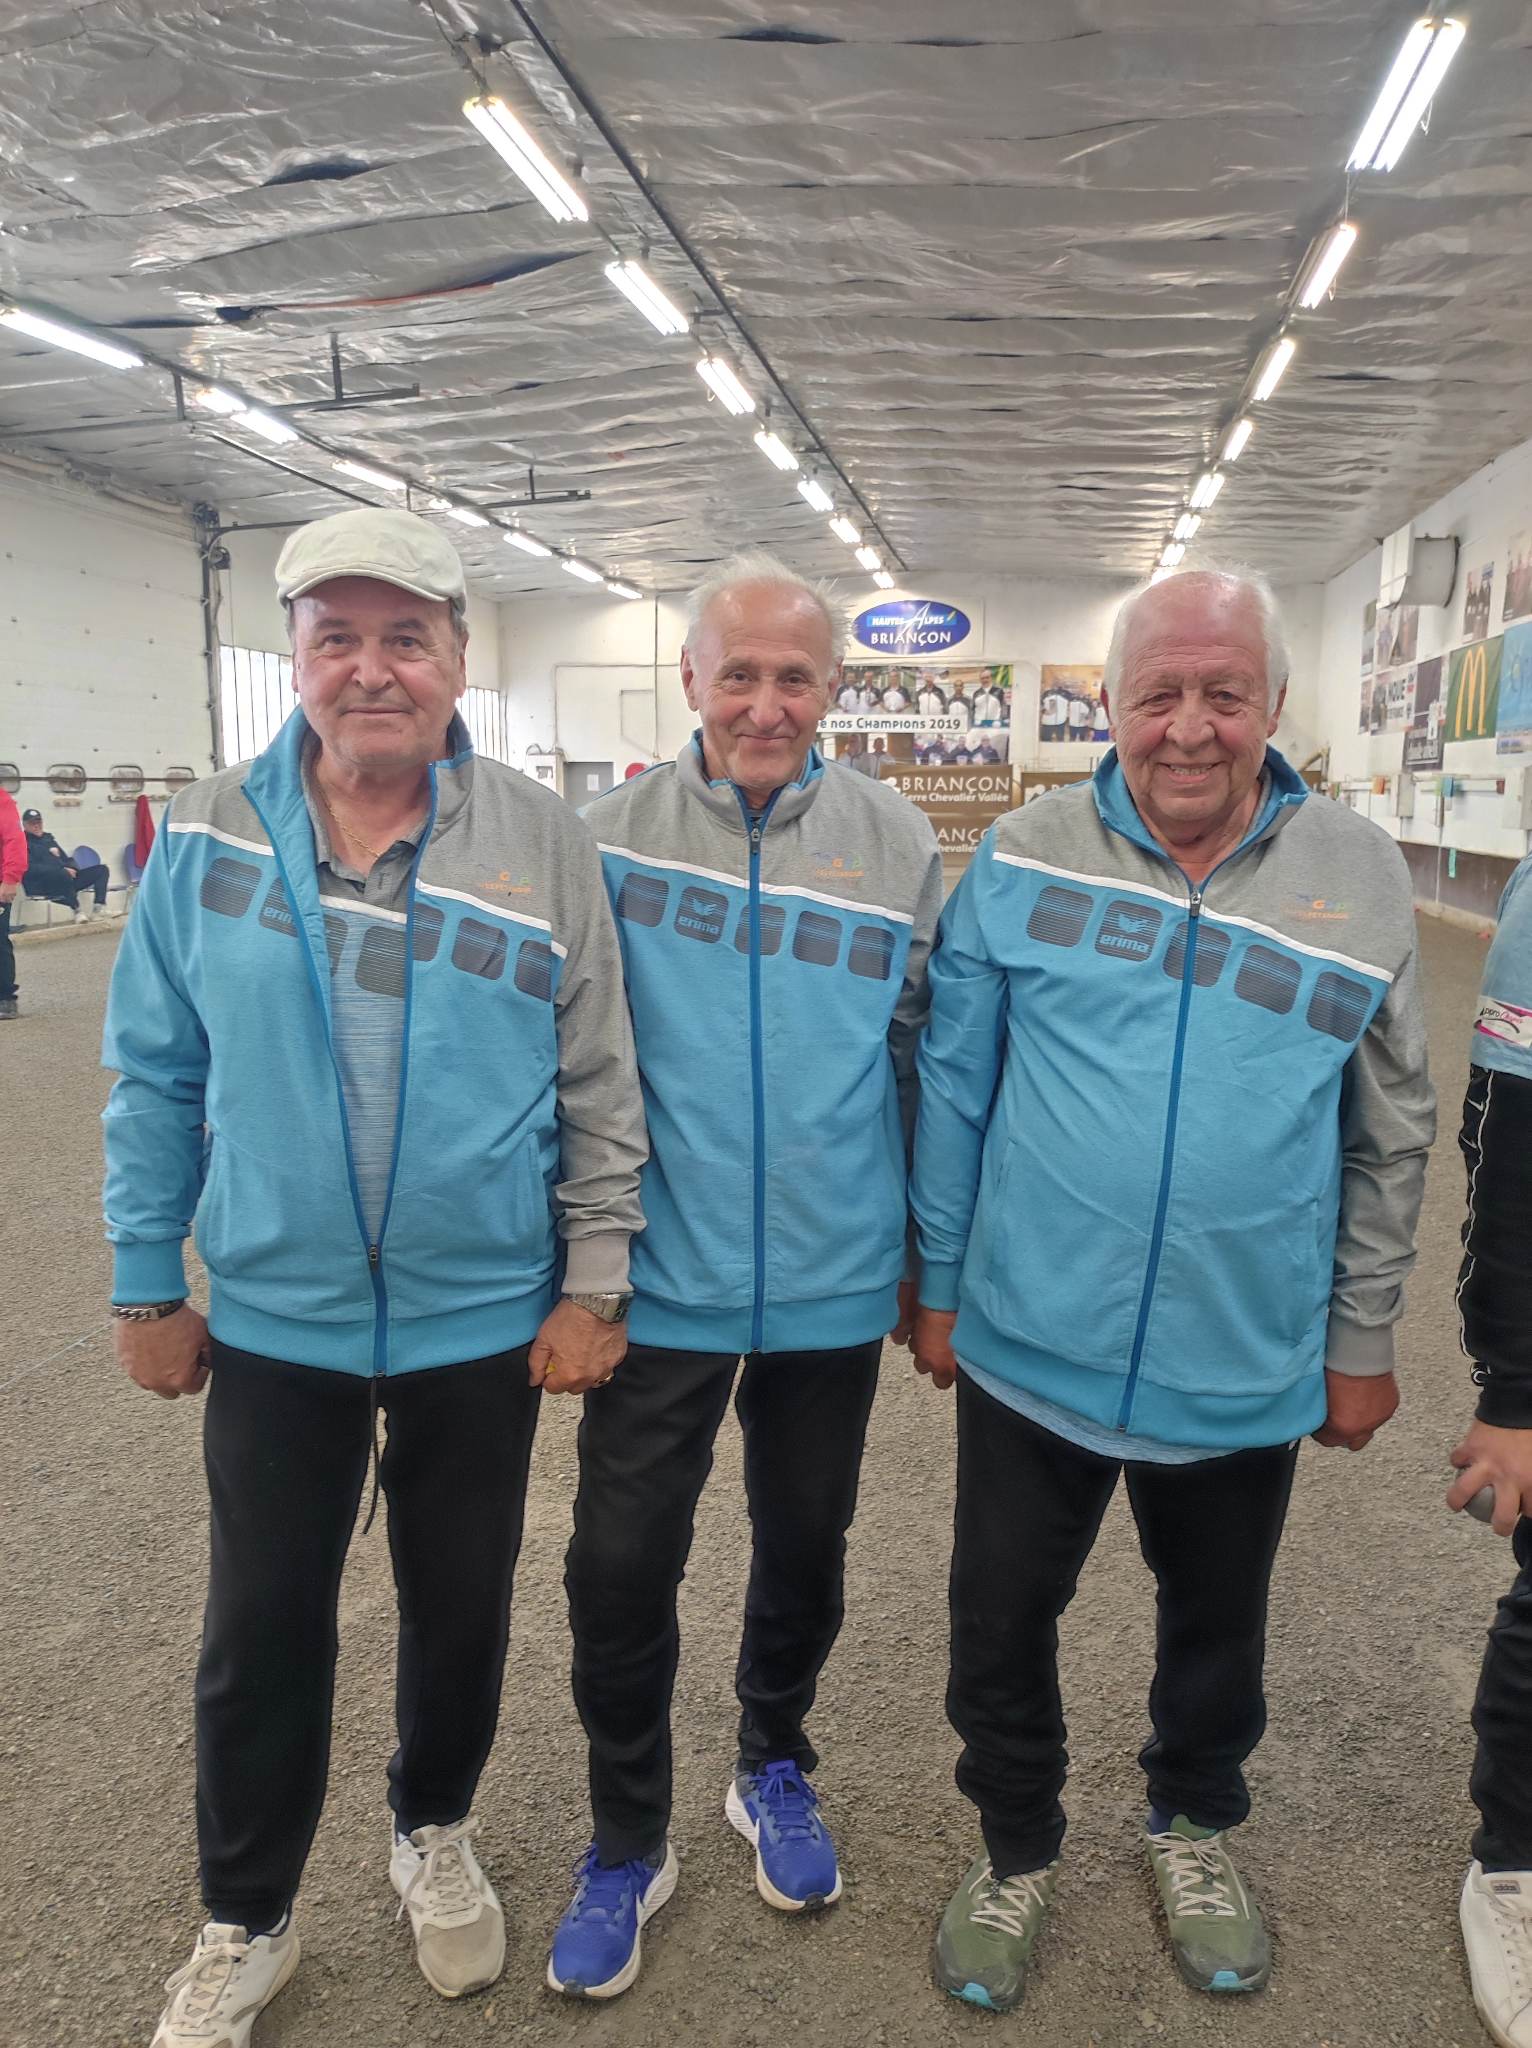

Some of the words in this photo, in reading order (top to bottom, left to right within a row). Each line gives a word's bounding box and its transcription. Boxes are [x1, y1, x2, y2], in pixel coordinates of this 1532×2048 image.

[871, 631, 951, 646] BRIANÇON
[831, 720, 852, 728] nos
[930, 719, 961, 729] 2019
[902, 776, 1010, 795] BRIANÇON
[929, 792, 976, 801] Chevalier
[978, 792, 1009, 801] Vallée
[679, 916, 720, 935] erima
[1100, 935, 1150, 952] erima
